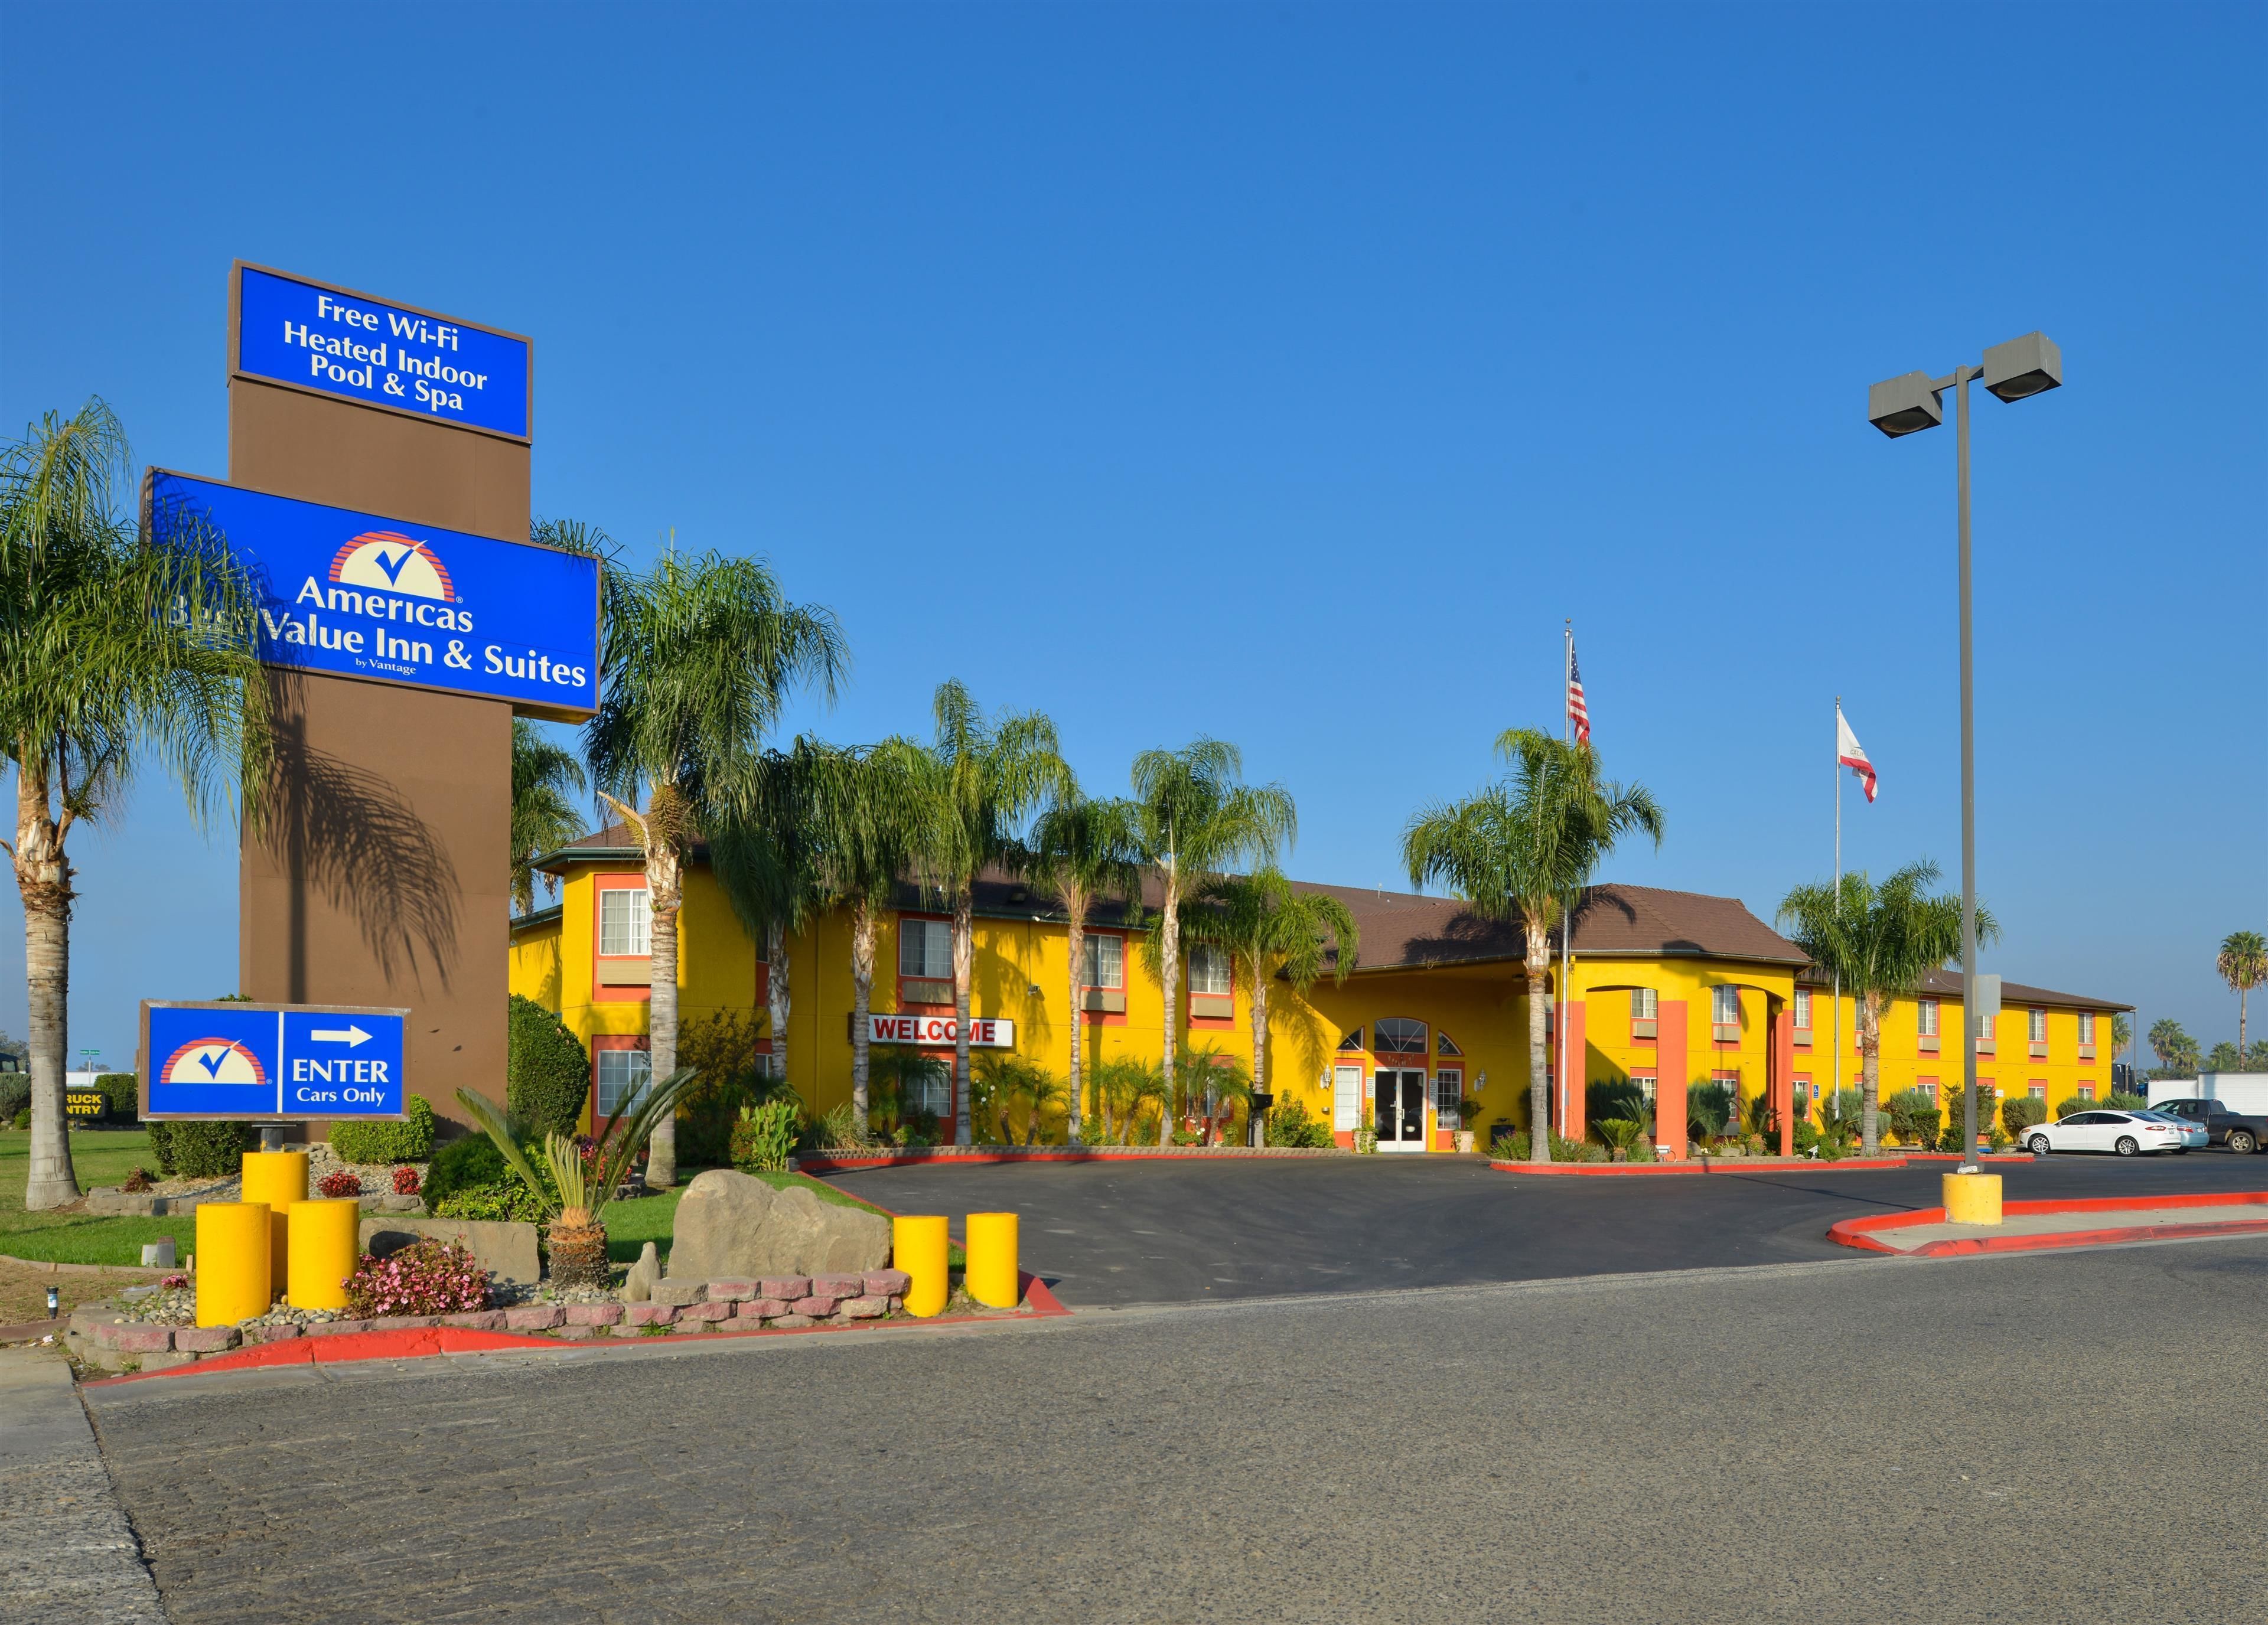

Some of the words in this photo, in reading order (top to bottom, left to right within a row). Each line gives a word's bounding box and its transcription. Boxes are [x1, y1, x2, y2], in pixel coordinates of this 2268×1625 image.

[318, 295, 378, 331] Free
[387, 313, 458, 351] Wi-Fi
[284, 321, 387, 367] Heated
[399, 349, 487, 390] Indoor
[311, 354, 372, 389] Pool
[383, 373, 405, 397] &
[415, 379, 464, 412] Spa
[296, 576, 473, 632] Americas
[259, 608, 364, 653] Value
[376, 628, 432, 664] Inn
[444, 639, 472, 670] &
[484, 645, 586, 687] Suites
[356, 657, 367, 668] by
[369, 658, 416, 676] Vantage
[874, 1018, 996, 1043] WELCOME
[293, 1059, 390, 1083] ENTER
[66, 1094, 102, 1104] RUCK
[66, 1105, 102, 1114] NTRY
[296, 1087, 337, 1102] Cars
[343, 1087, 385, 1107] Only
